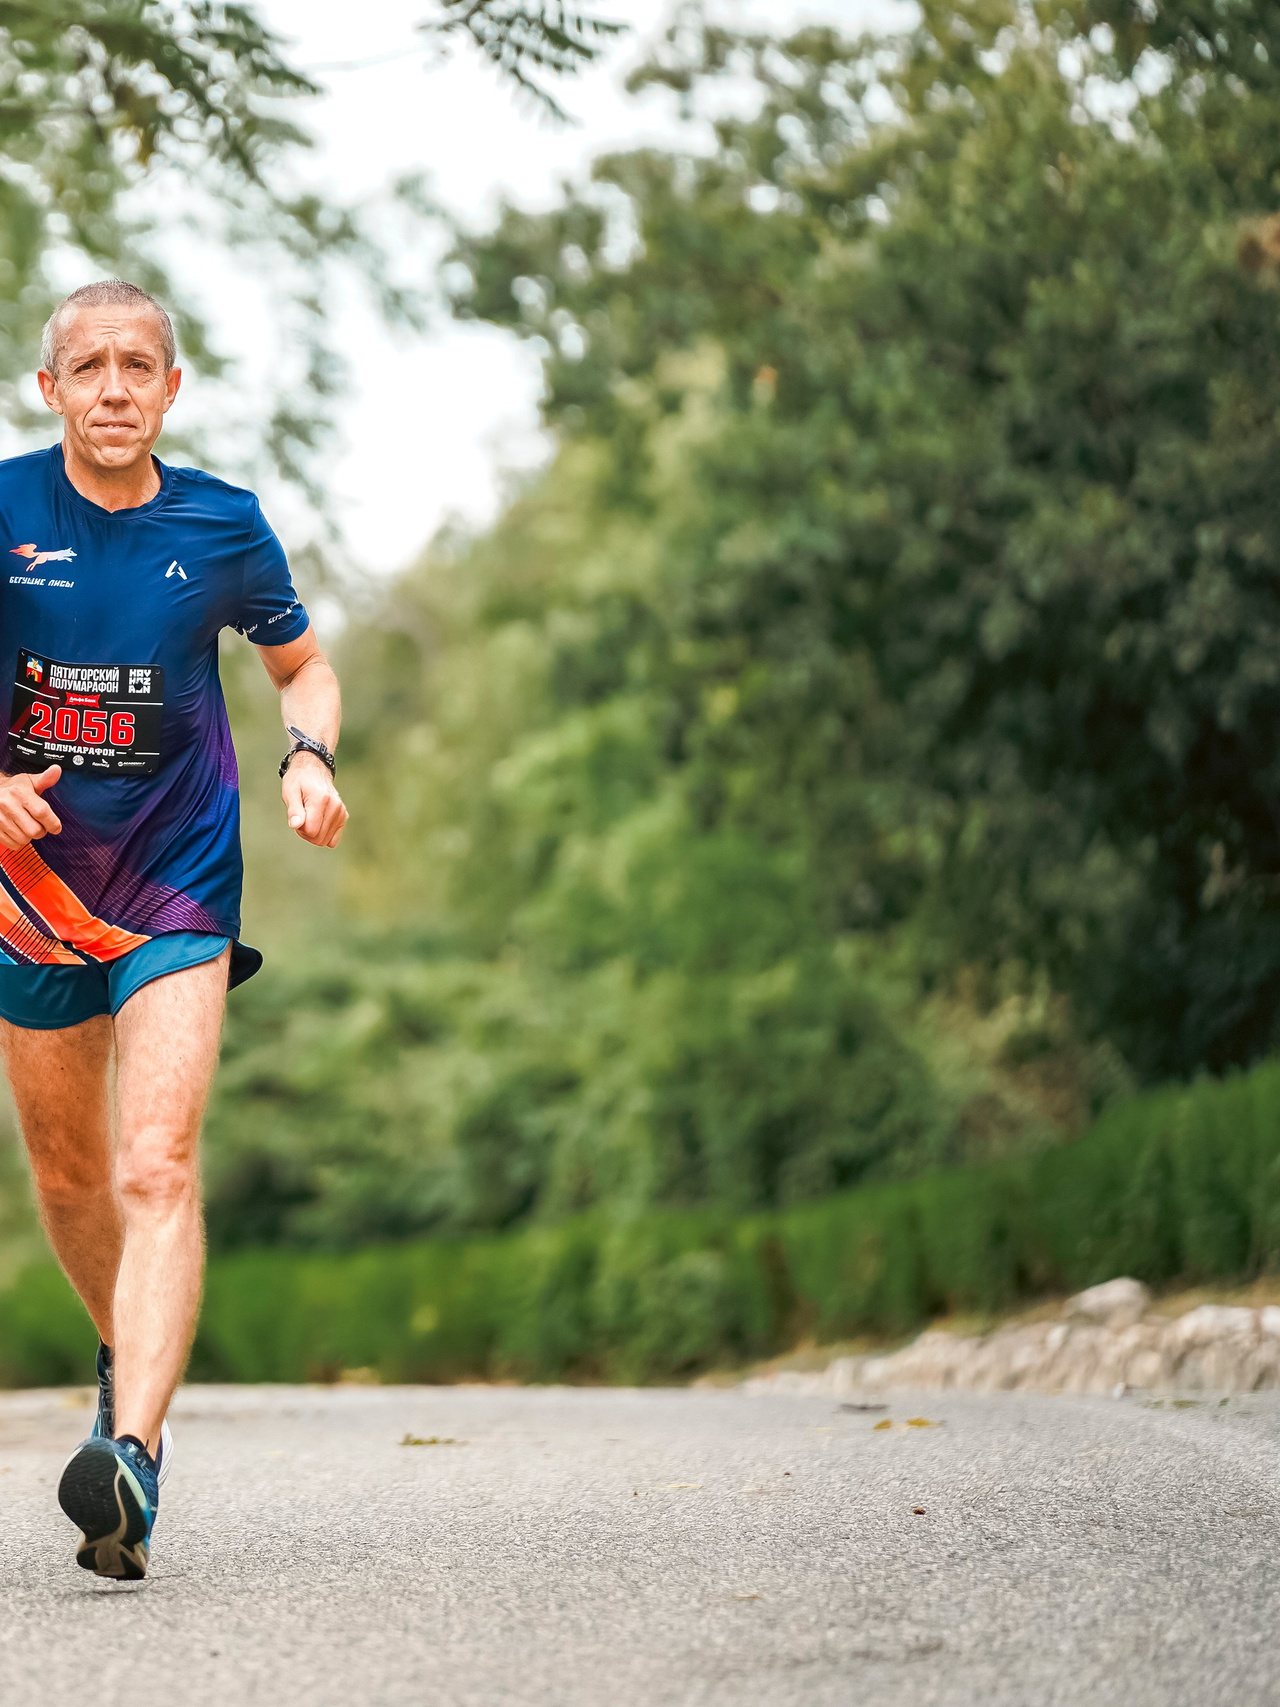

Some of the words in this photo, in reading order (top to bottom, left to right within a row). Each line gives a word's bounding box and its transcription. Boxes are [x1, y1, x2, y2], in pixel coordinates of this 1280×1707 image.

[48, 580, 75, 588] ЛИСЫ
[50, 664, 120, 682] ПЯТИГОРСКИЙ
[49, 678, 119, 693] ПОЛУМАРАФОН
[30, 701, 136, 746] 2056
[44, 741, 116, 757] ПОЛУМАРАФОН
